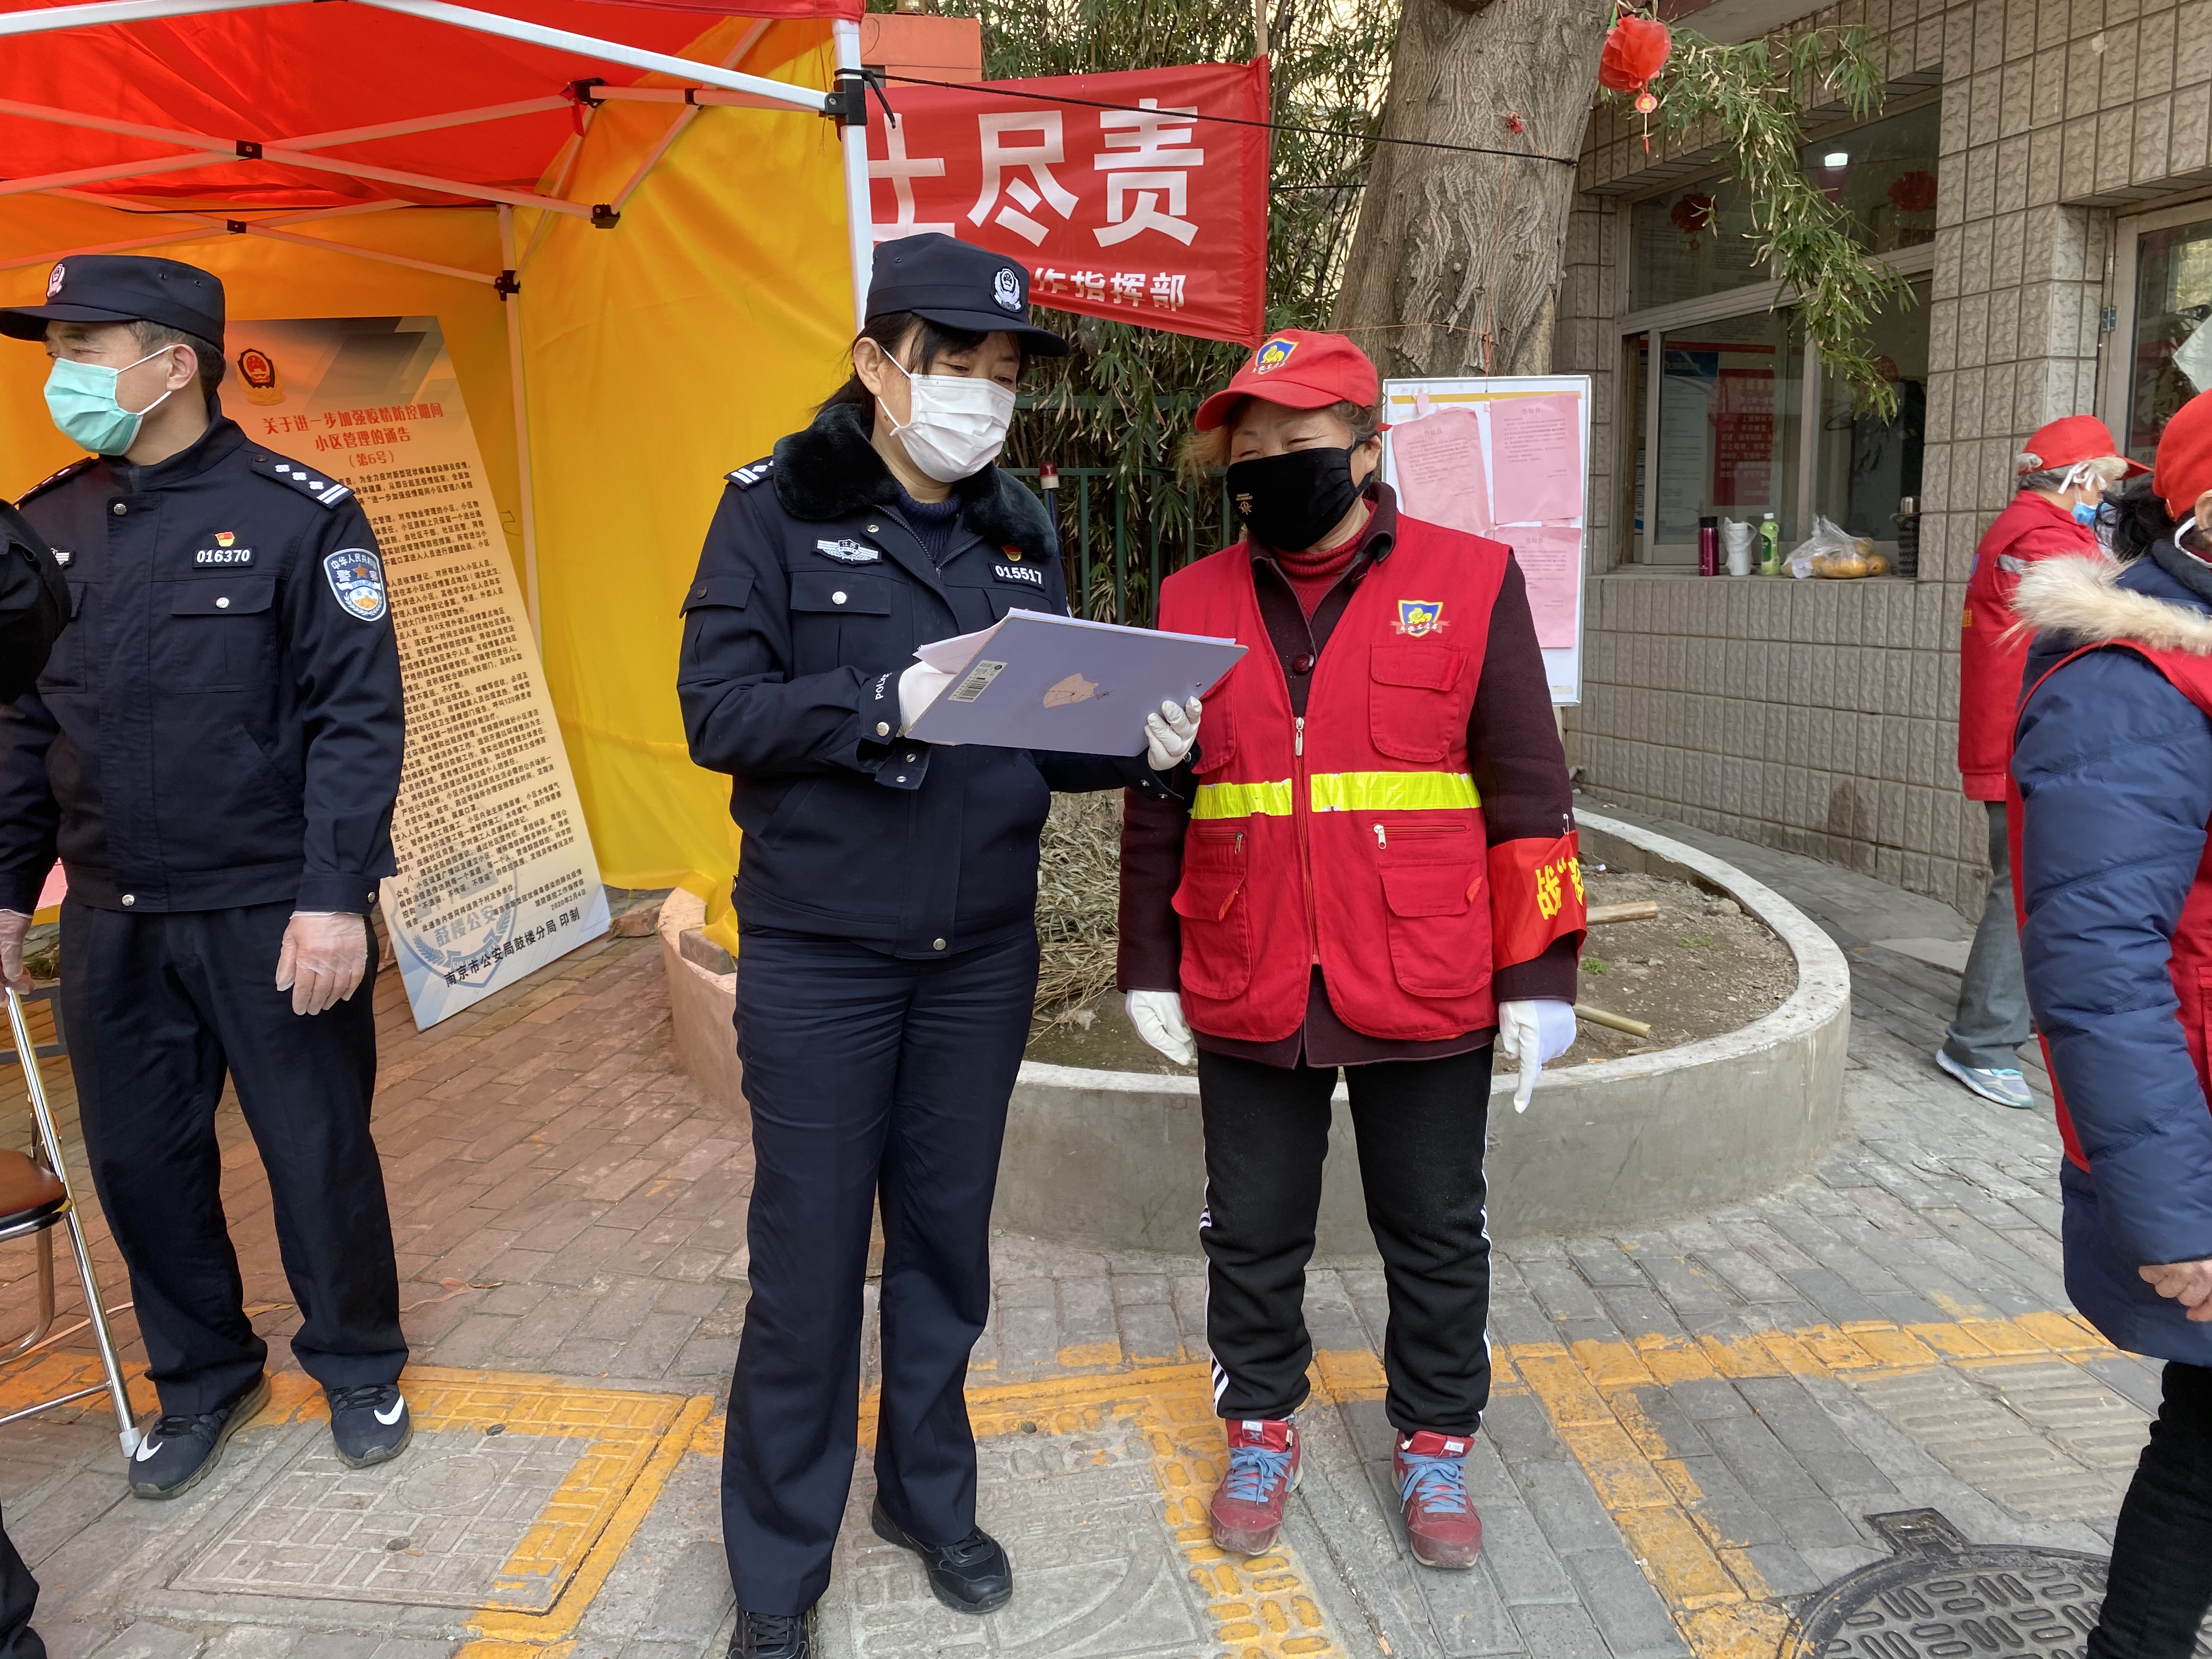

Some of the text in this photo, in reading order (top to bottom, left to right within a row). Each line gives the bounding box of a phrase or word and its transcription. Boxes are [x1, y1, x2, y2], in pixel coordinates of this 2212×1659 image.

[262, 403, 444, 435] 关于进一步加强疫情防控期间
[315, 427, 411, 452] 小区管理的通告
[196, 549, 250, 563] 016370
[995, 565, 1042, 584] 015517
[551, 889, 586, 911] 2020年2月4日
[443, 906, 580, 988] 南京市公安局鼓楼分局 印制
